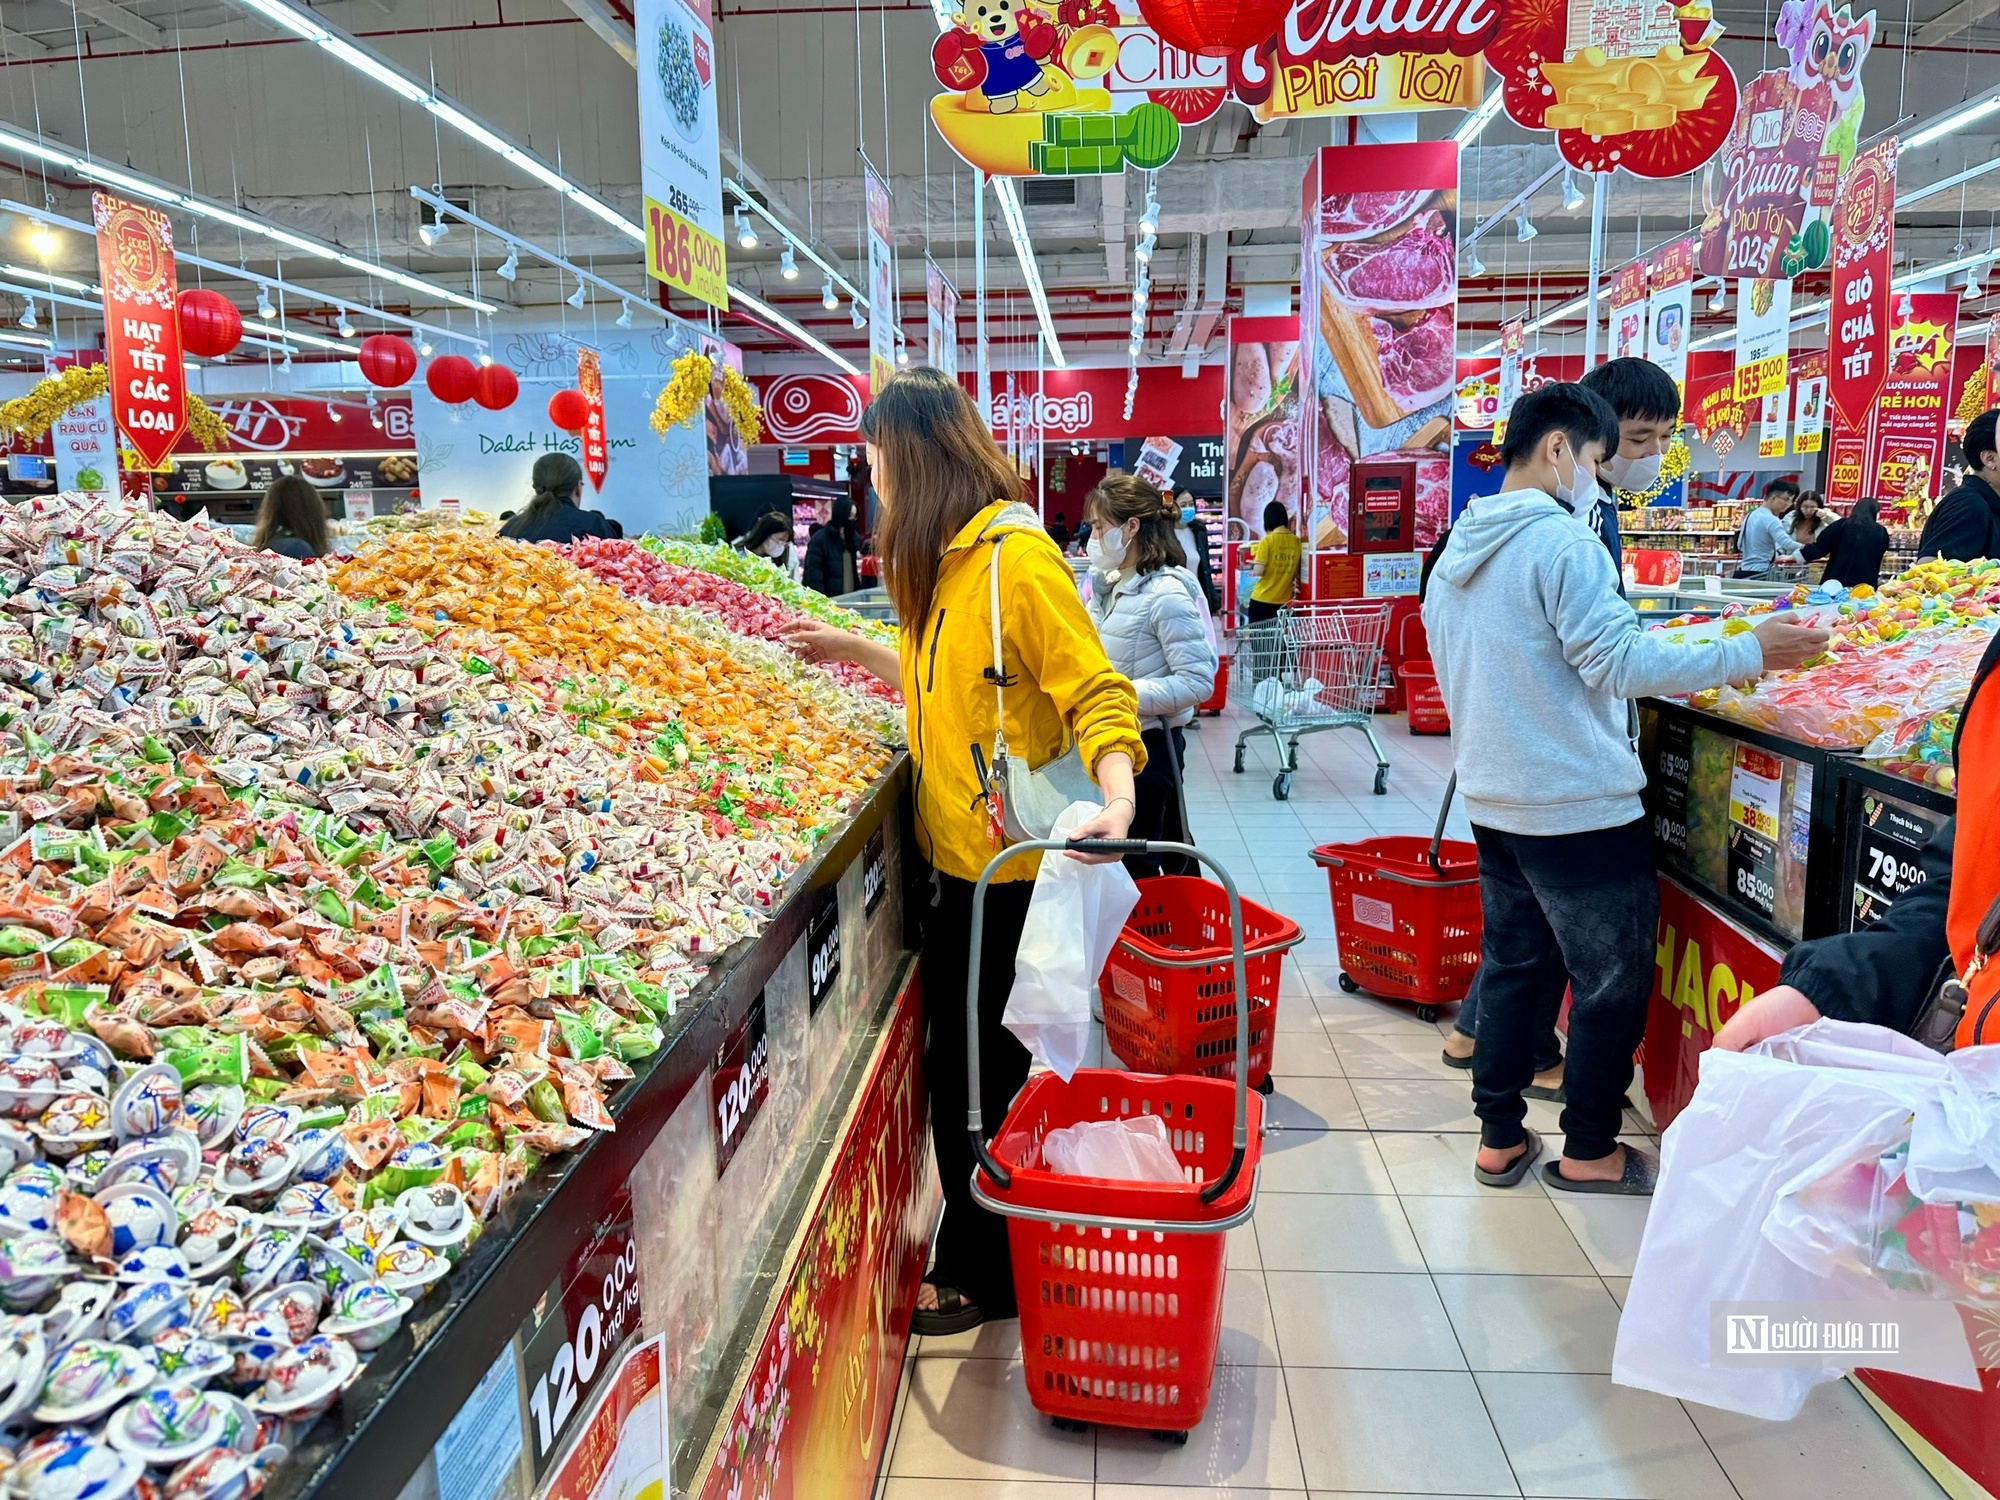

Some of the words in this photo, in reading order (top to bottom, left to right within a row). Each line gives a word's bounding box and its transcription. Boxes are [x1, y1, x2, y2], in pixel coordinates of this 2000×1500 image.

[1282, 56, 1378, 113] Phát
[1399, 50, 1462, 104] Tài
[1723, 149, 1800, 218] Xuân
[1733, 207, 1760, 236] Phát
[1763, 204, 1785, 233] Tài
[650, 207, 721, 286] 186.000
[1728, 235, 1774, 274] 2025
[1845, 269, 1873, 306] GIÒ
[123, 318, 162, 345] HẠT
[1841, 303, 1875, 345] CHẢ
[128, 344, 166, 374] TẾT
[1842, 342, 1873, 381] TẾT
[129, 376, 171, 402] CÁC
[1738, 358, 1783, 398] 155.000
[1886, 380, 1911, 390] LUÔN
[1912, 380, 1939, 390] LUÔN
[1034, 396, 1088, 428] loại
[1880, 391, 1902, 408] RẺ
[1904, 394, 1942, 408] HƠN
[59, 425, 85, 433] RAU
[89, 418, 106, 433] CỦ
[128, 407, 174, 435] LOẠI
[70, 437, 99, 452] QUẢ
[479, 431, 536, 455] Dalat
[1760, 439, 1783, 456] 225.000
[1797, 434, 1820, 451] 99.000
[1190, 459, 1215, 478] hải
[1834, 467, 1859, 480] 2.000
[1373, 512, 1393, 528] 218
[1660, 751, 1689, 777] 65.000
[1654, 814, 1686, 841] 90.000
[1743, 806, 1771, 828] 38.000
[1889, 812, 1905, 827] Thạch
[1905, 818, 1913, 830] trà
[1913, 823, 1923, 834] sữa
[1868, 846, 1927, 888] 79.000
[1737, 867, 1774, 900] 85.000
[812, 924, 839, 996] 90.000
[718, 1033, 767, 1147] 120.000
[601, 1279, 639, 1350] vnđ/kg
[529, 1238, 636, 1457] 120.000
